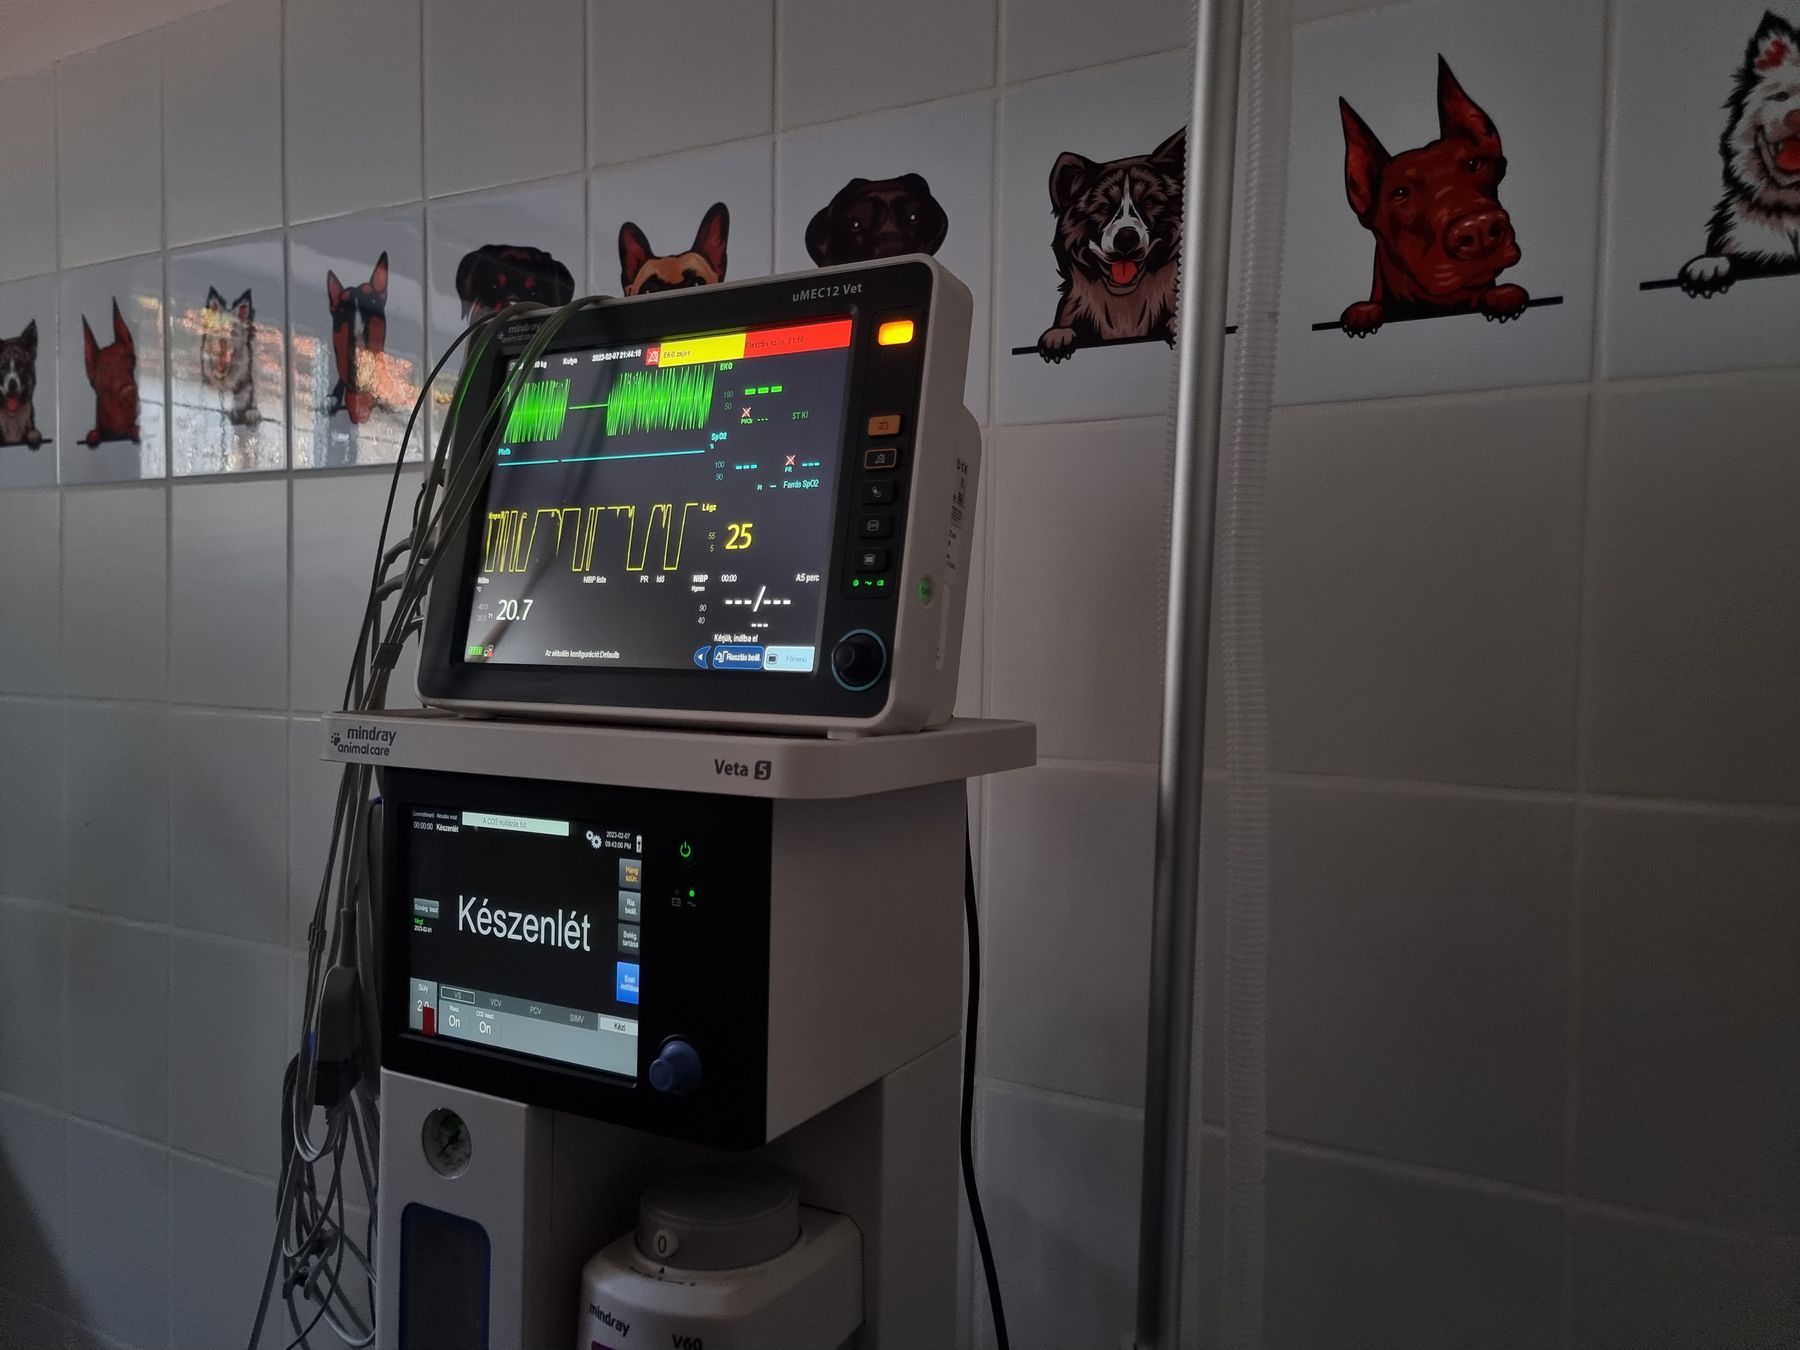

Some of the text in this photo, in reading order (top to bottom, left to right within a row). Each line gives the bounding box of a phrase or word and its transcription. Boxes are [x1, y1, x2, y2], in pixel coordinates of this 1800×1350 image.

[792, 283, 863, 302] uMEC12 Vet
[663, 351, 676, 359] EKG
[720, 362, 733, 371] EKG
[711, 432, 728, 442] SpO2
[702, 503, 718, 512] Légz
[725, 523, 754, 550] 25
[640, 575, 649, 583] PR
[496, 599, 534, 621] 20.7
[347, 725, 397, 746] mindray
[714, 759, 748, 777] Veta
[623, 842, 632, 850] PM
[459, 894, 591, 956] Készenlét
[490, 998, 502, 1007] VCV
[529, 1005, 542, 1015] PCV
[448, 1014, 460, 1029] On
[569, 1013, 585, 1024] SIMV
[479, 1020, 492, 1035] On
[589, 1302, 631, 1338] mindray
